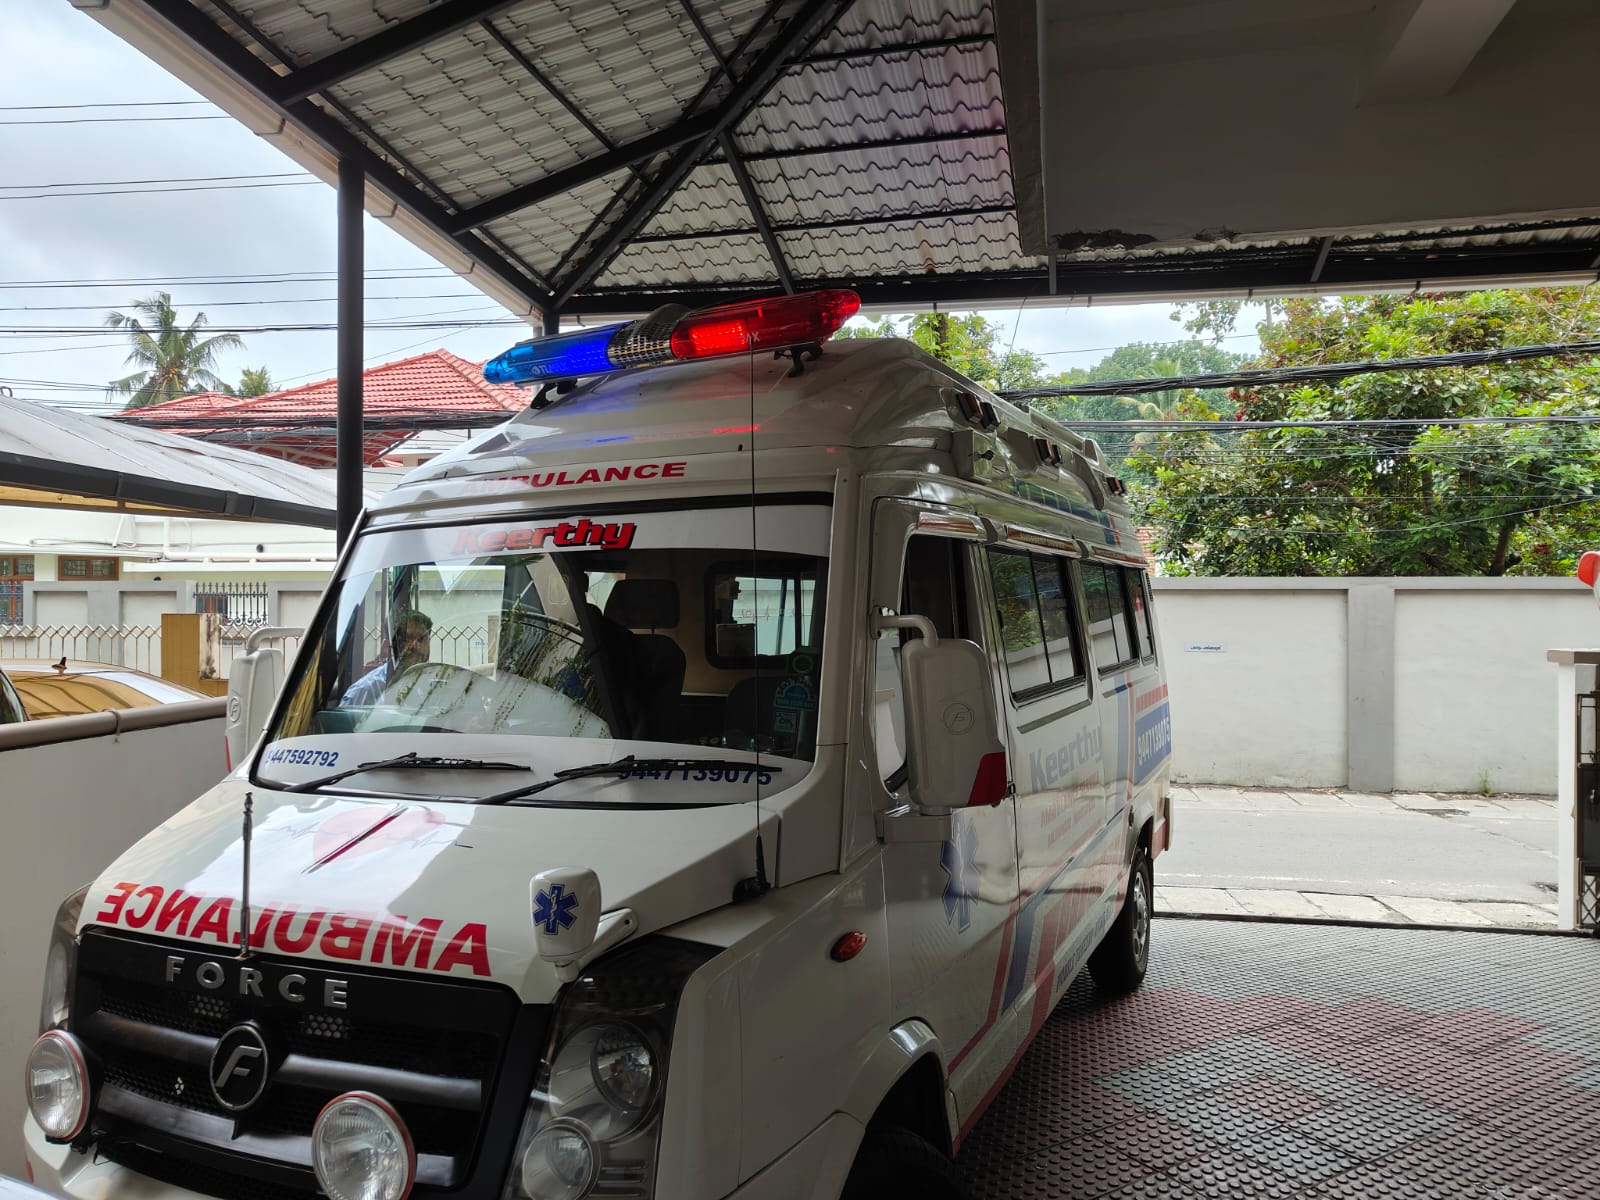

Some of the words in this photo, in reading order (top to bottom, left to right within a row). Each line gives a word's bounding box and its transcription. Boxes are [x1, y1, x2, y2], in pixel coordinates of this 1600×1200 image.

[453, 518, 637, 553] Keerthy
[1029, 724, 1103, 795] Keerthy
[165, 956, 348, 1009] FORCE
